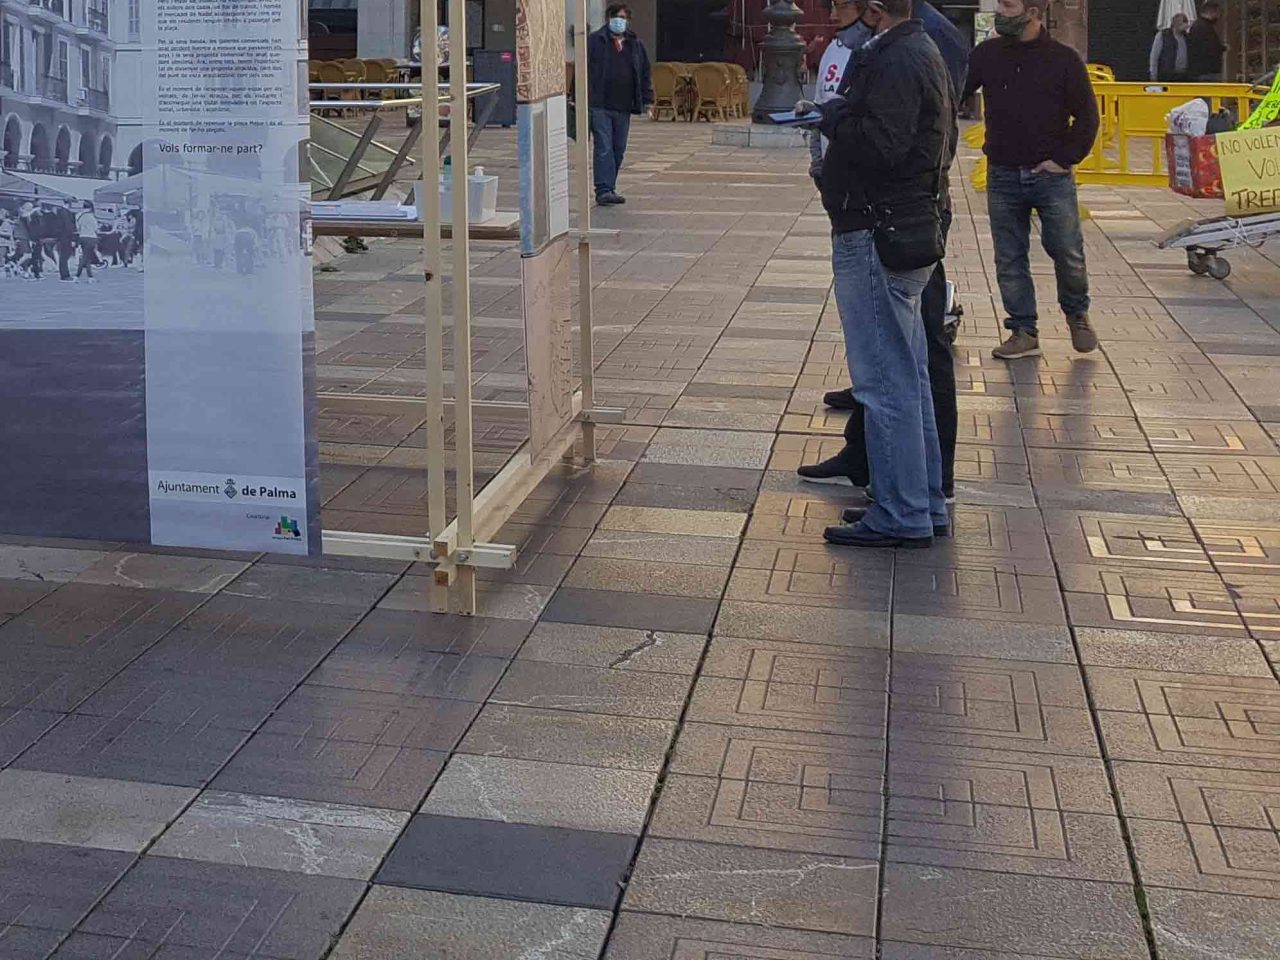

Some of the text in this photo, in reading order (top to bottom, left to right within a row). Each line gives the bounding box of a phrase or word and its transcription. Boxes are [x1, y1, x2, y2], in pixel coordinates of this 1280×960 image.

[158, 143, 263, 155] Vols formar-ne part?
[1221, 140, 1241, 156] NO
[157, 480, 297, 499] Ajuntament de Palma
